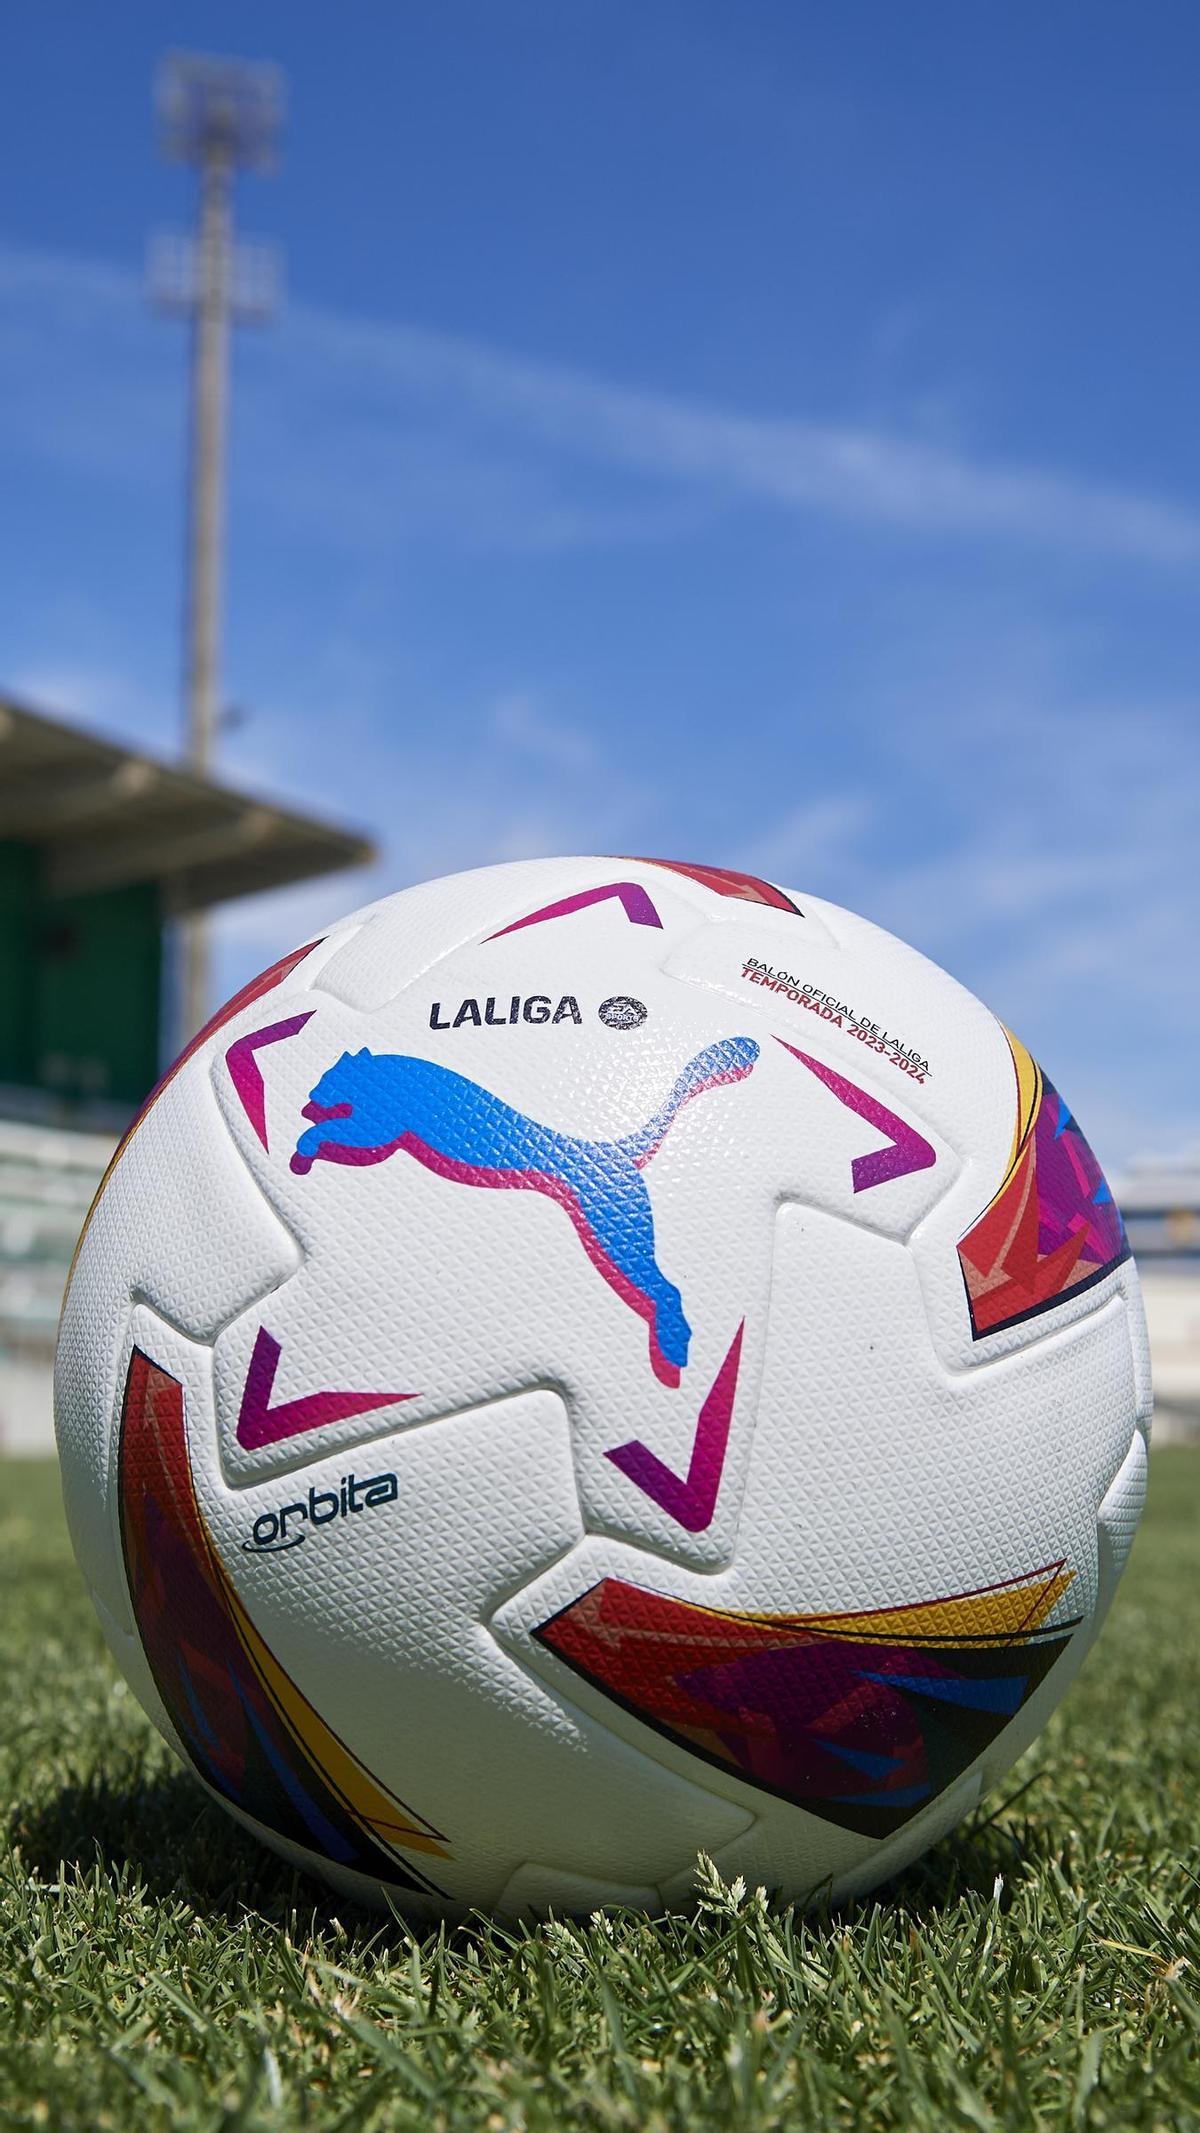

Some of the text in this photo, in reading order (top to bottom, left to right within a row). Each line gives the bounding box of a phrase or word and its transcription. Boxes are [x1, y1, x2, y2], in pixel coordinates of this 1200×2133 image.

[429, 995, 583, 1031] LALIGA
[740, 966, 926, 1085] TEMPORADA 2023-2024
[746, 957, 931, 1071] BALÓN OFICIAL DE LALIGA
[252, 1472, 399, 1546] orbita
